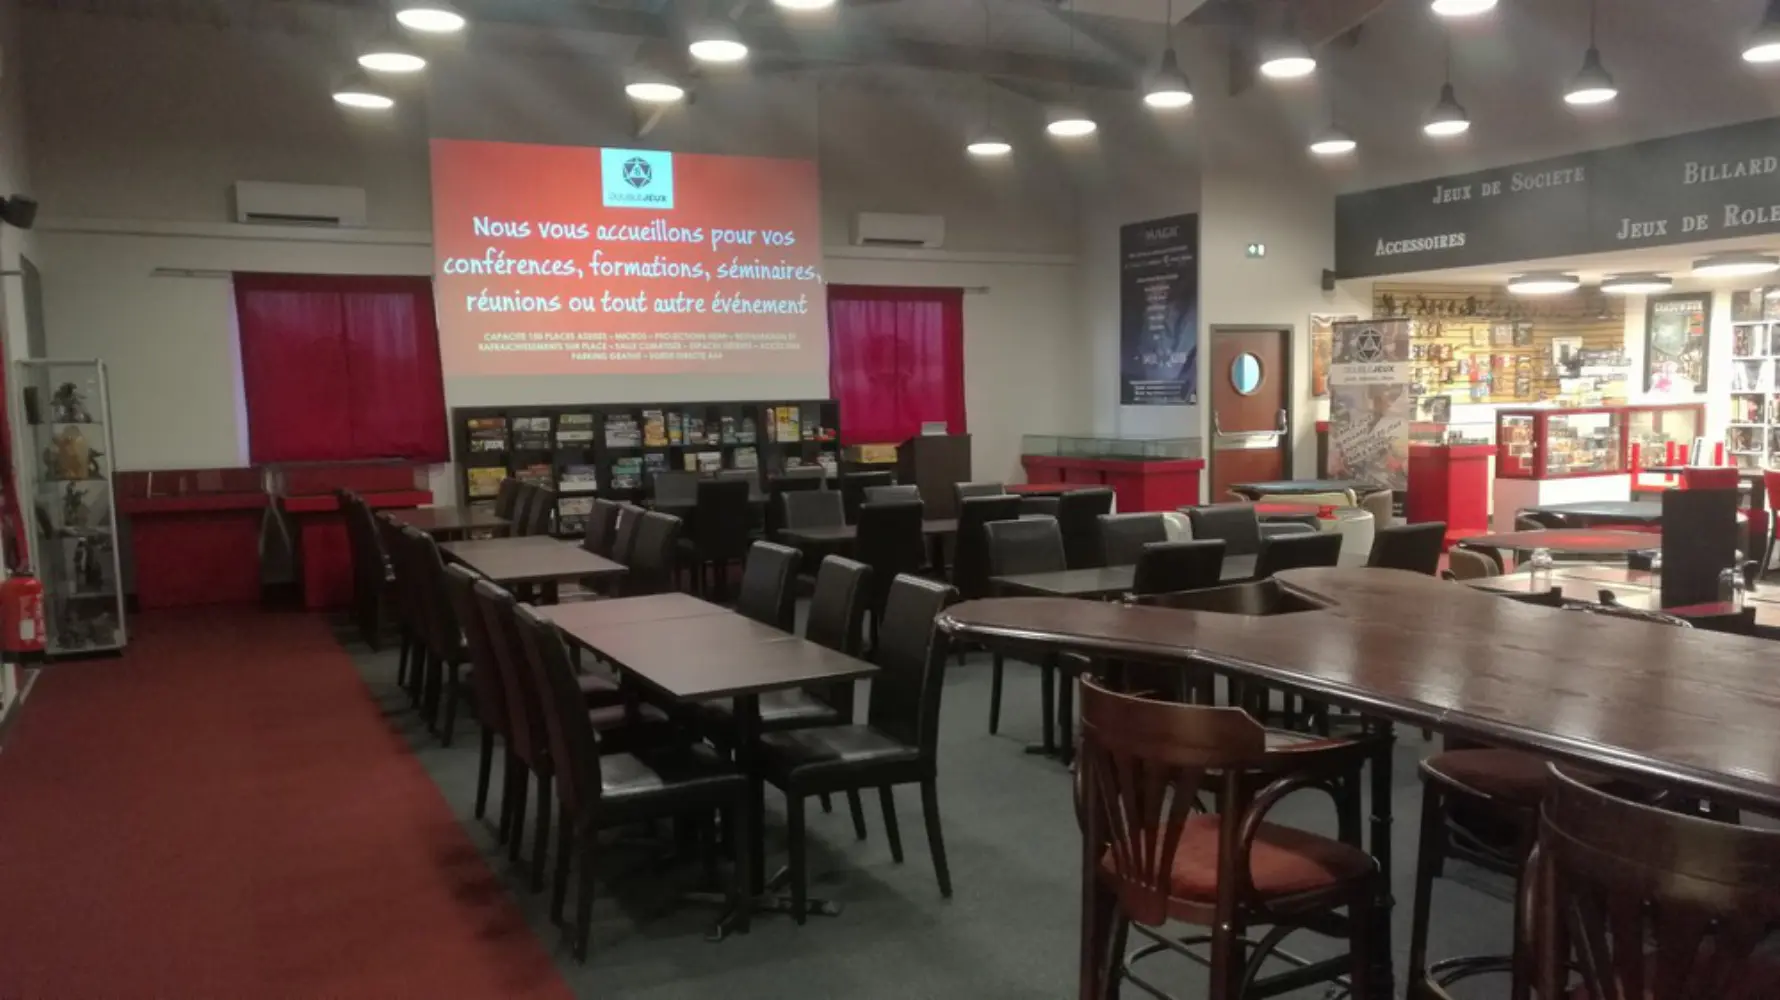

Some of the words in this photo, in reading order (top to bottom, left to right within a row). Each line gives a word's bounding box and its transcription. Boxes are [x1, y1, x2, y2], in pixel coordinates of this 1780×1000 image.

[1432, 184, 1472, 205] JEUX
[1480, 179, 1502, 197] DE
[1510, 166, 1586, 192] SOCIETE
[1683, 156, 1778, 184] BILLARD
[472, 215, 531, 238] Nous
[538, 221, 590, 240] vous
[596, 219, 704, 244] accueillons
[711, 226, 756, 252] pour
[762, 228, 795, 246] vos
[1616, 218, 1668, 241] JEUX
[1681, 214, 1709, 232] DE
[1723, 204, 1780, 228] ROLE
[1374, 232, 1466, 256] ACCESSOIRES
[443, 246, 584, 280] conférences,
[589, 249, 711, 281] formations,
[716, 256, 823, 285] séminaires,
[466, 287, 562, 313] réunions
[568, 295, 596, 313] ou
[600, 290, 648, 314] tout
[653, 293, 706, 315] autre
[711, 290, 809, 316] événement
